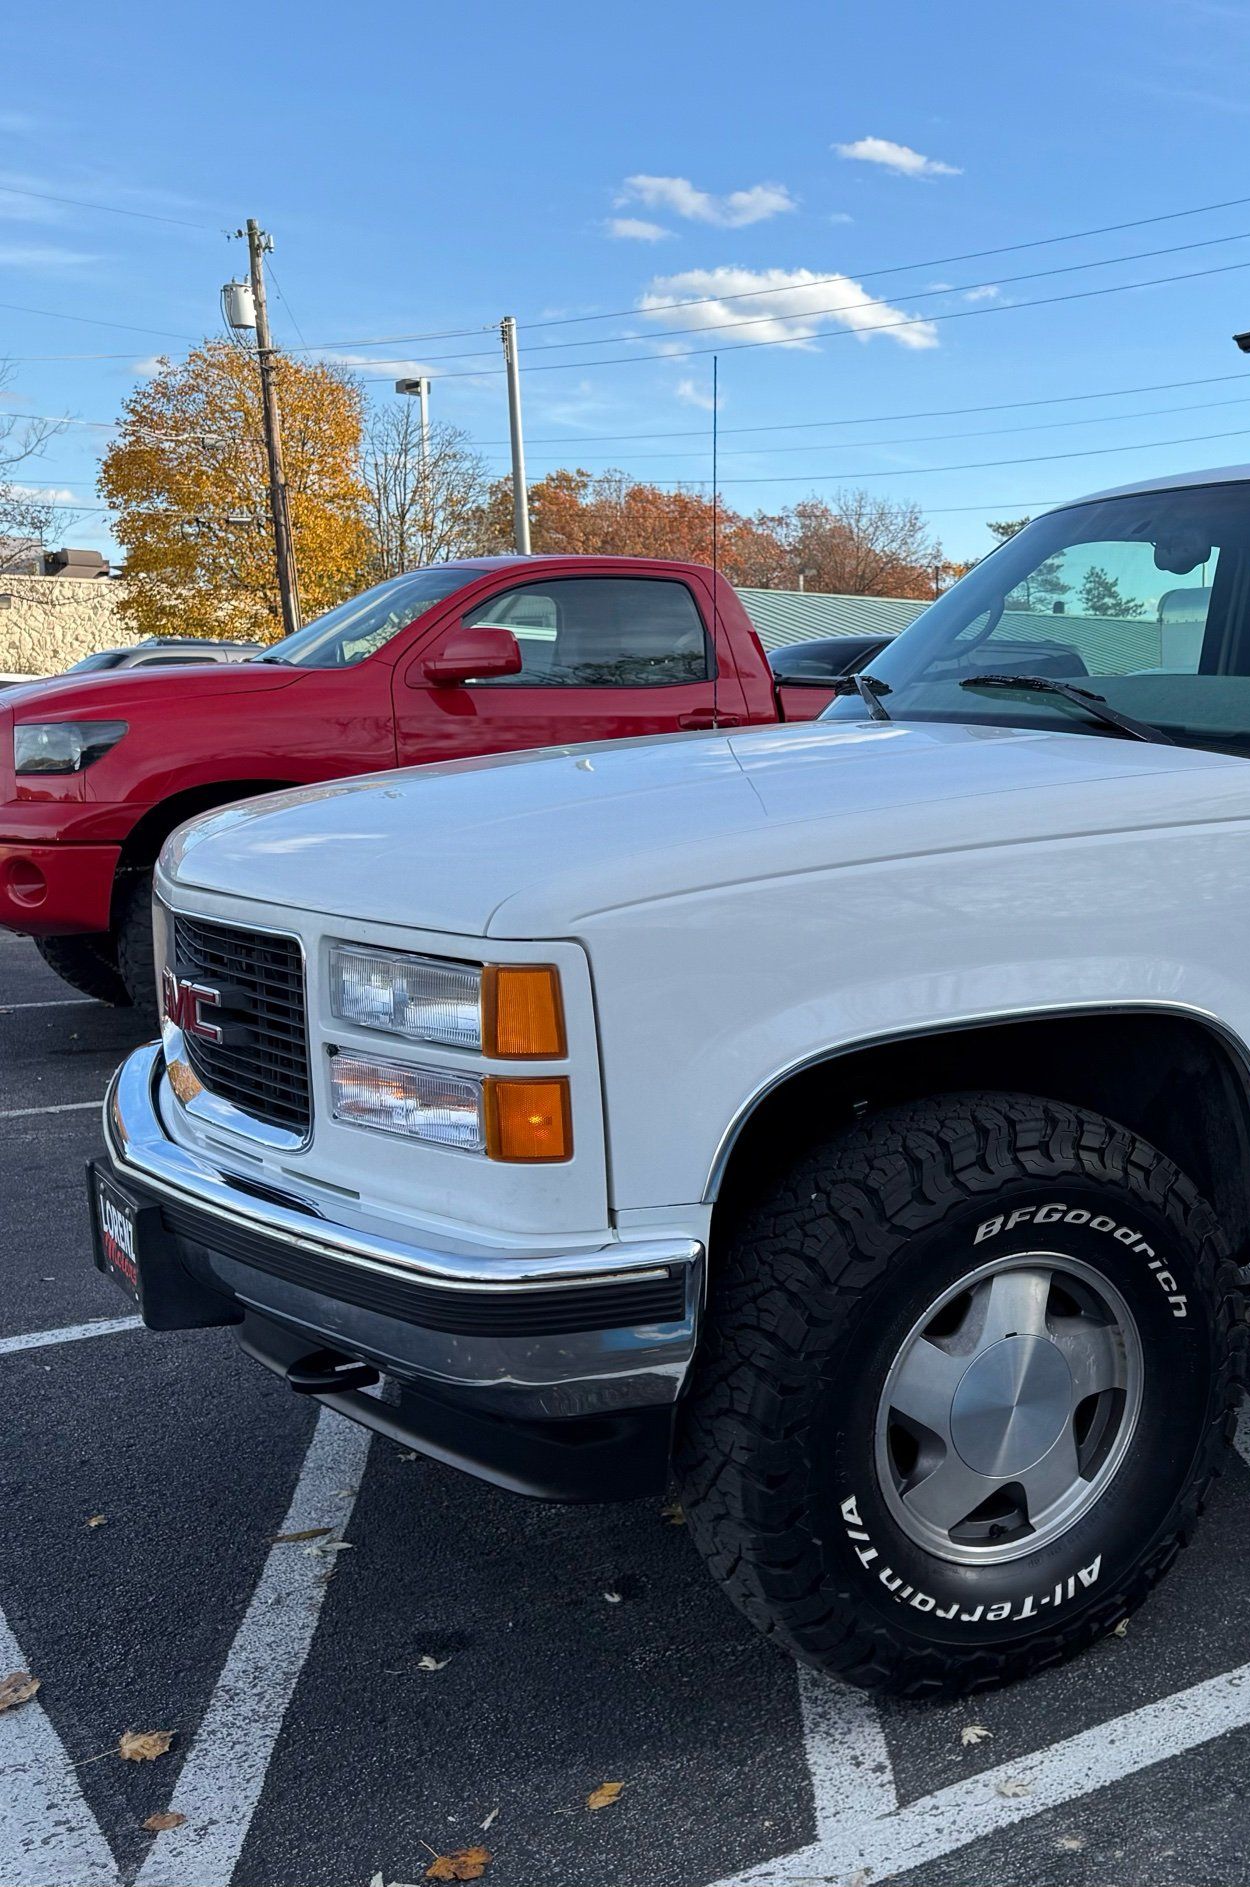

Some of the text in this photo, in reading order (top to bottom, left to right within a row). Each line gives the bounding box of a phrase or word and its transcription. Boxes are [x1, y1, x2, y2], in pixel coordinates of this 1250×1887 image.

[973, 1203, 1189, 1319] BFGoodrich
[839, 1493, 1103, 1623] All-Terrain T/A
